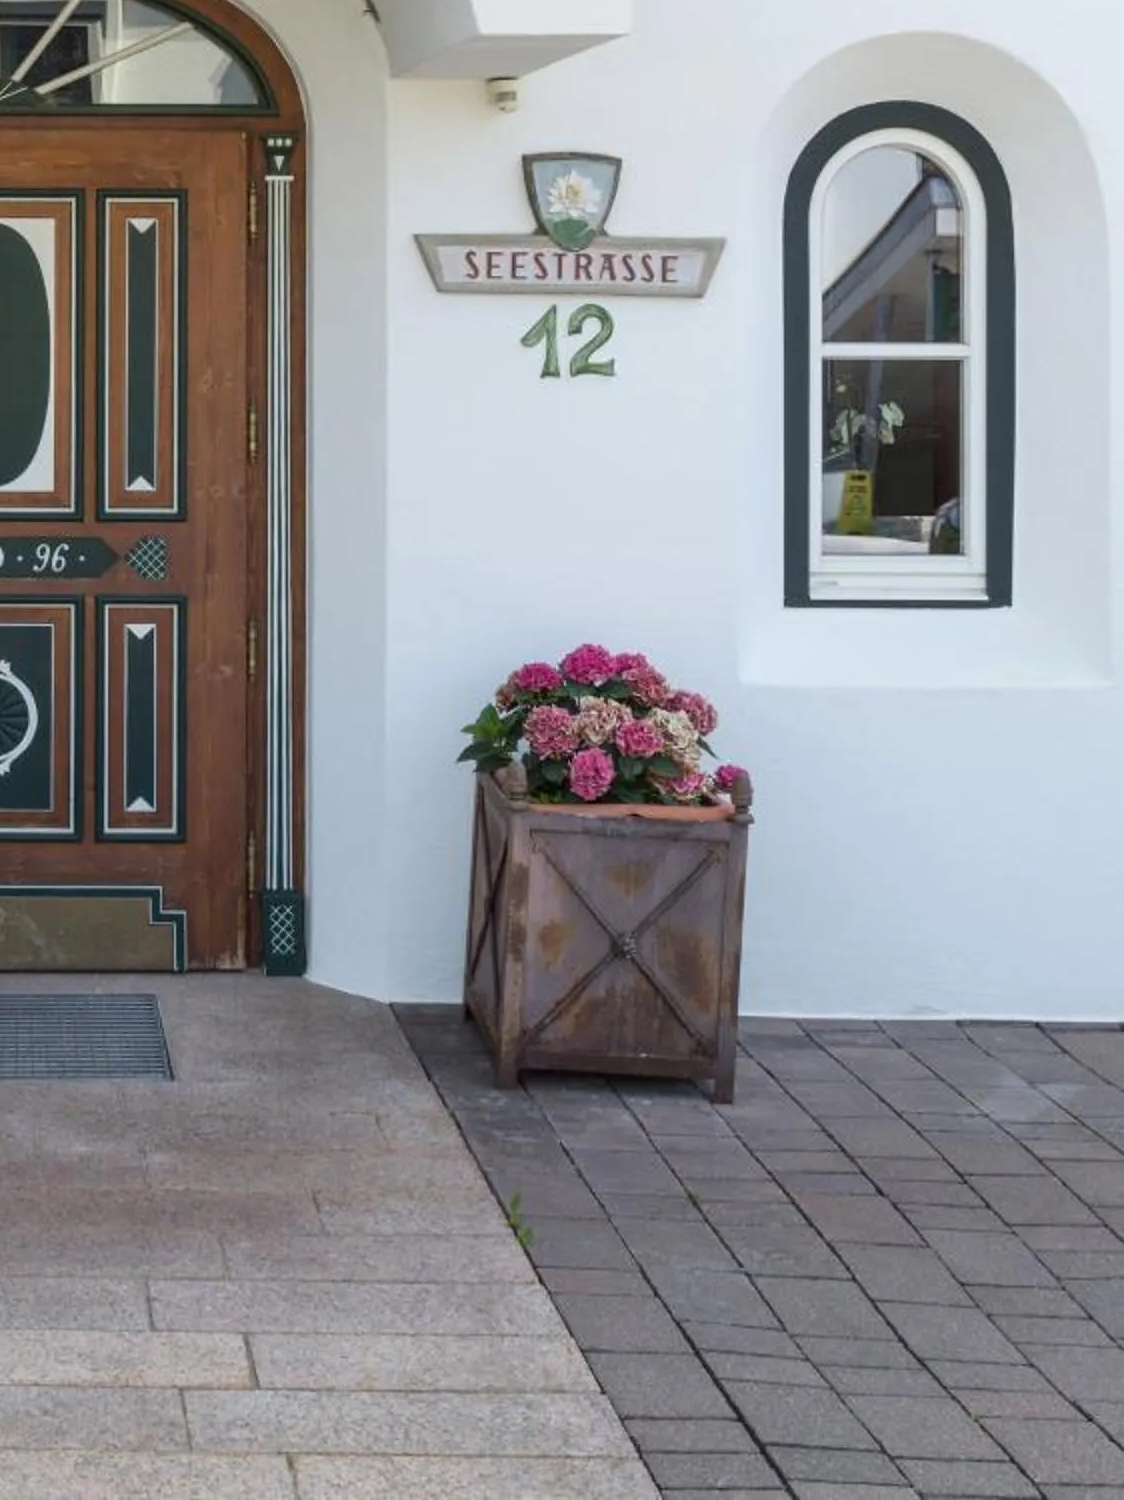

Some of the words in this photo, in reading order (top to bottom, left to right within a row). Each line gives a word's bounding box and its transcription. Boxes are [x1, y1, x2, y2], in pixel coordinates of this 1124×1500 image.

[464, 250, 680, 284] SEESTRASSE
[520, 303, 616, 379] 12
[32, 542, 70, 573] 96
